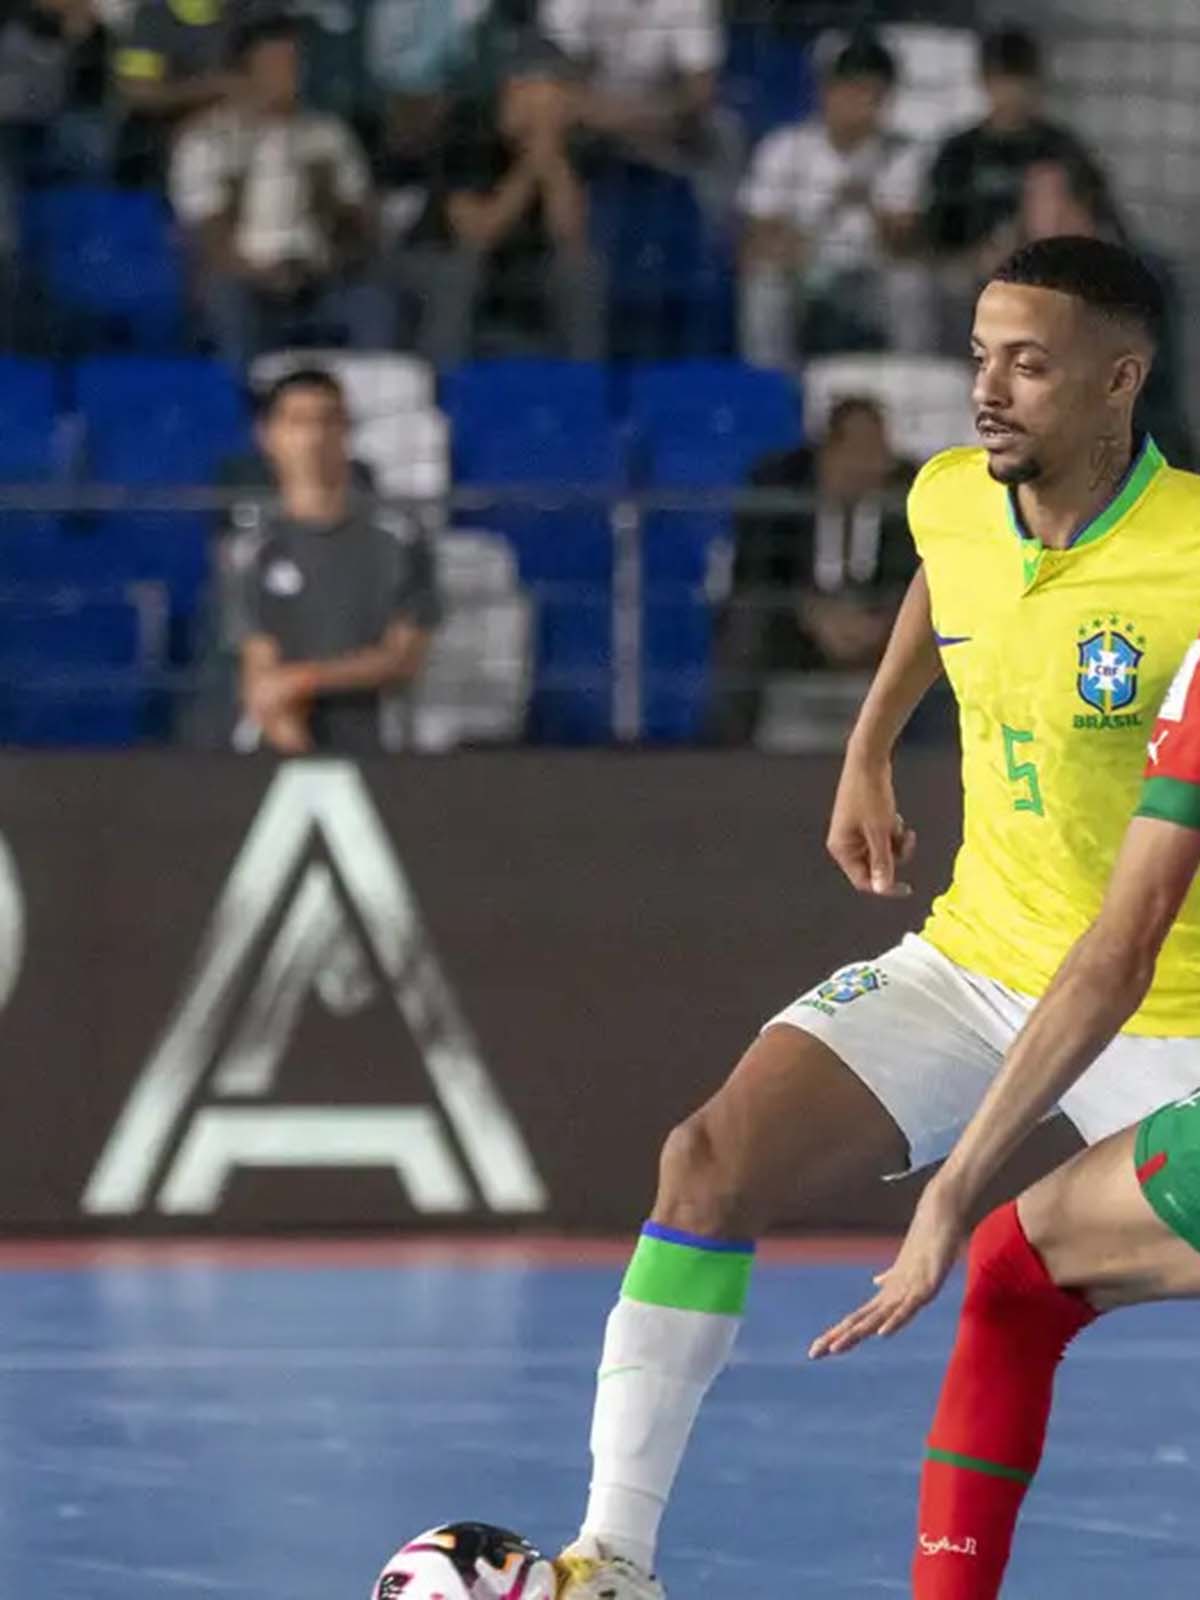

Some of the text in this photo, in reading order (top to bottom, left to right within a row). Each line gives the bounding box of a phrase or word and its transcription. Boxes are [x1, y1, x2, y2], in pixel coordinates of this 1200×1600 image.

[1073, 714, 1142, 729] BRASIL
[1000, 724, 1044, 817] 5
[0, 761, 546, 1213] A
